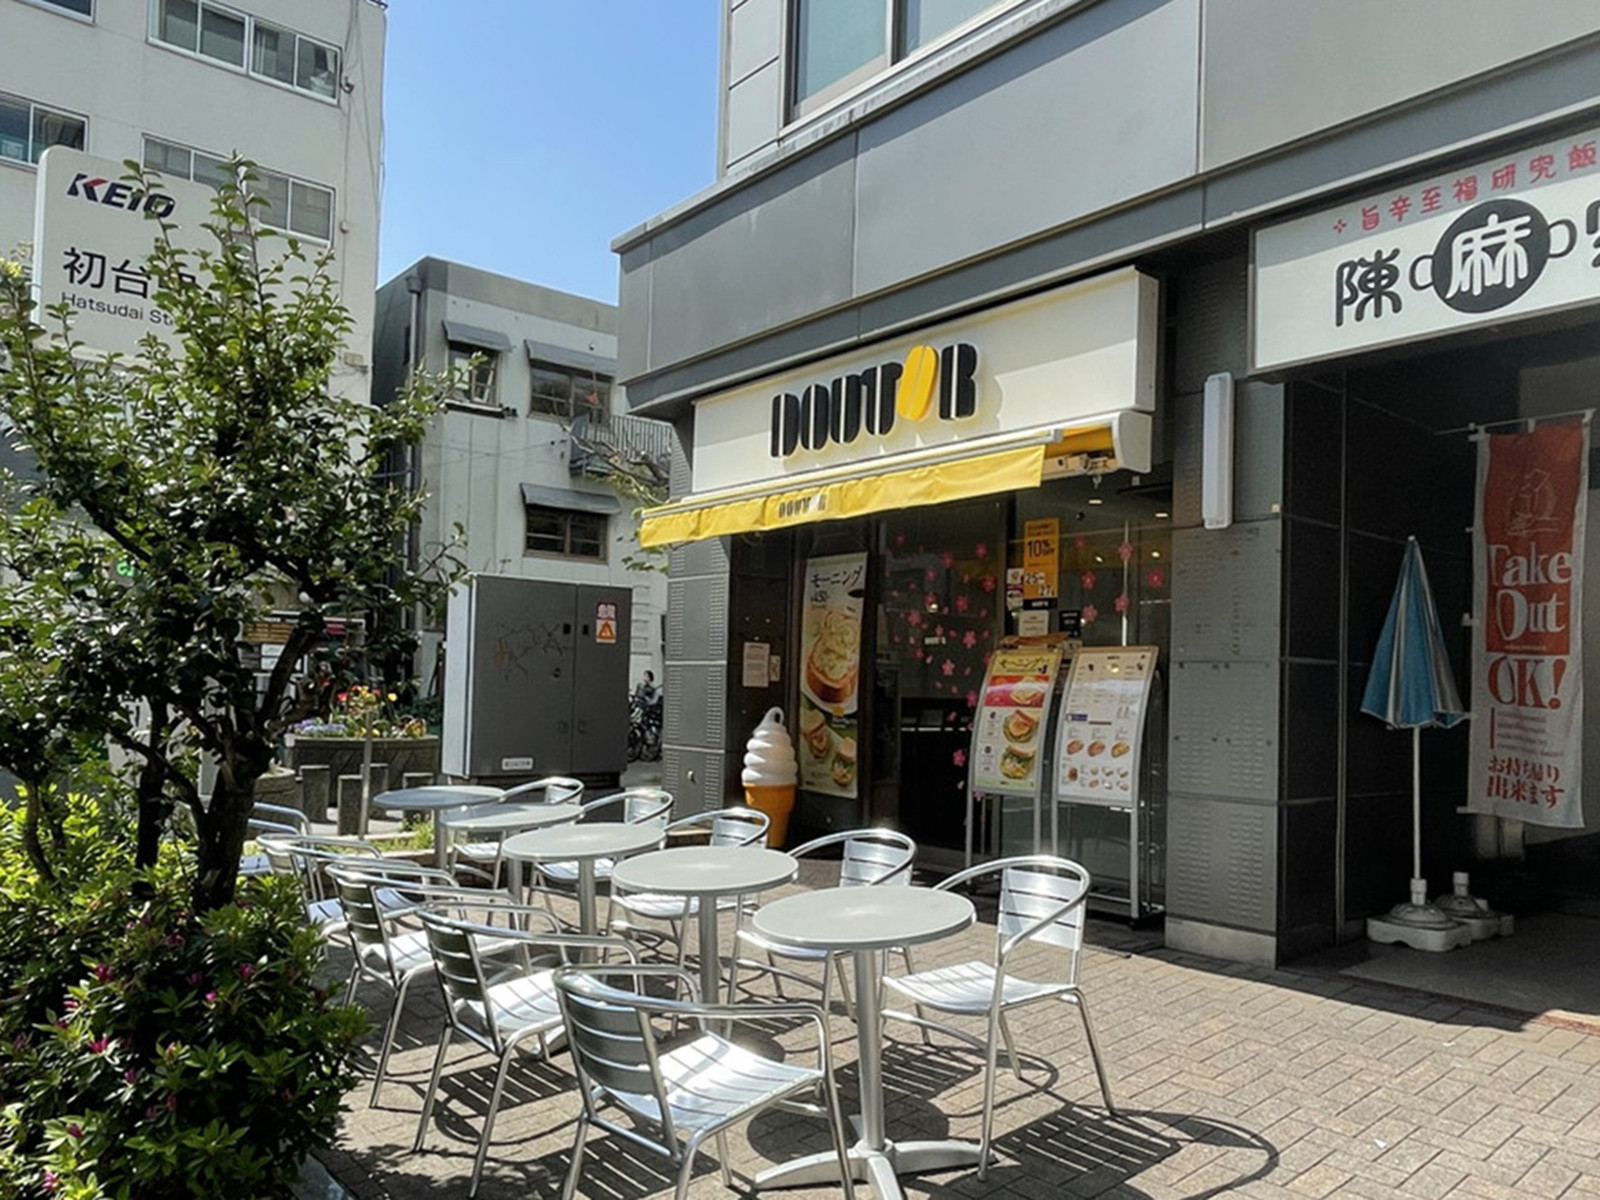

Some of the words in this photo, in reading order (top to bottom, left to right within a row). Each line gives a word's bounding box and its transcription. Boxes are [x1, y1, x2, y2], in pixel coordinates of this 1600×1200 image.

[66, 173, 176, 218] KEIO
[61, 291, 144, 321] Hatsudai
[770, 343, 977, 457] DOUTOR
[1488, 541, 1573, 587] Take
[1496, 588, 1566, 641] Out
[1487, 655, 1567, 710] OK!
